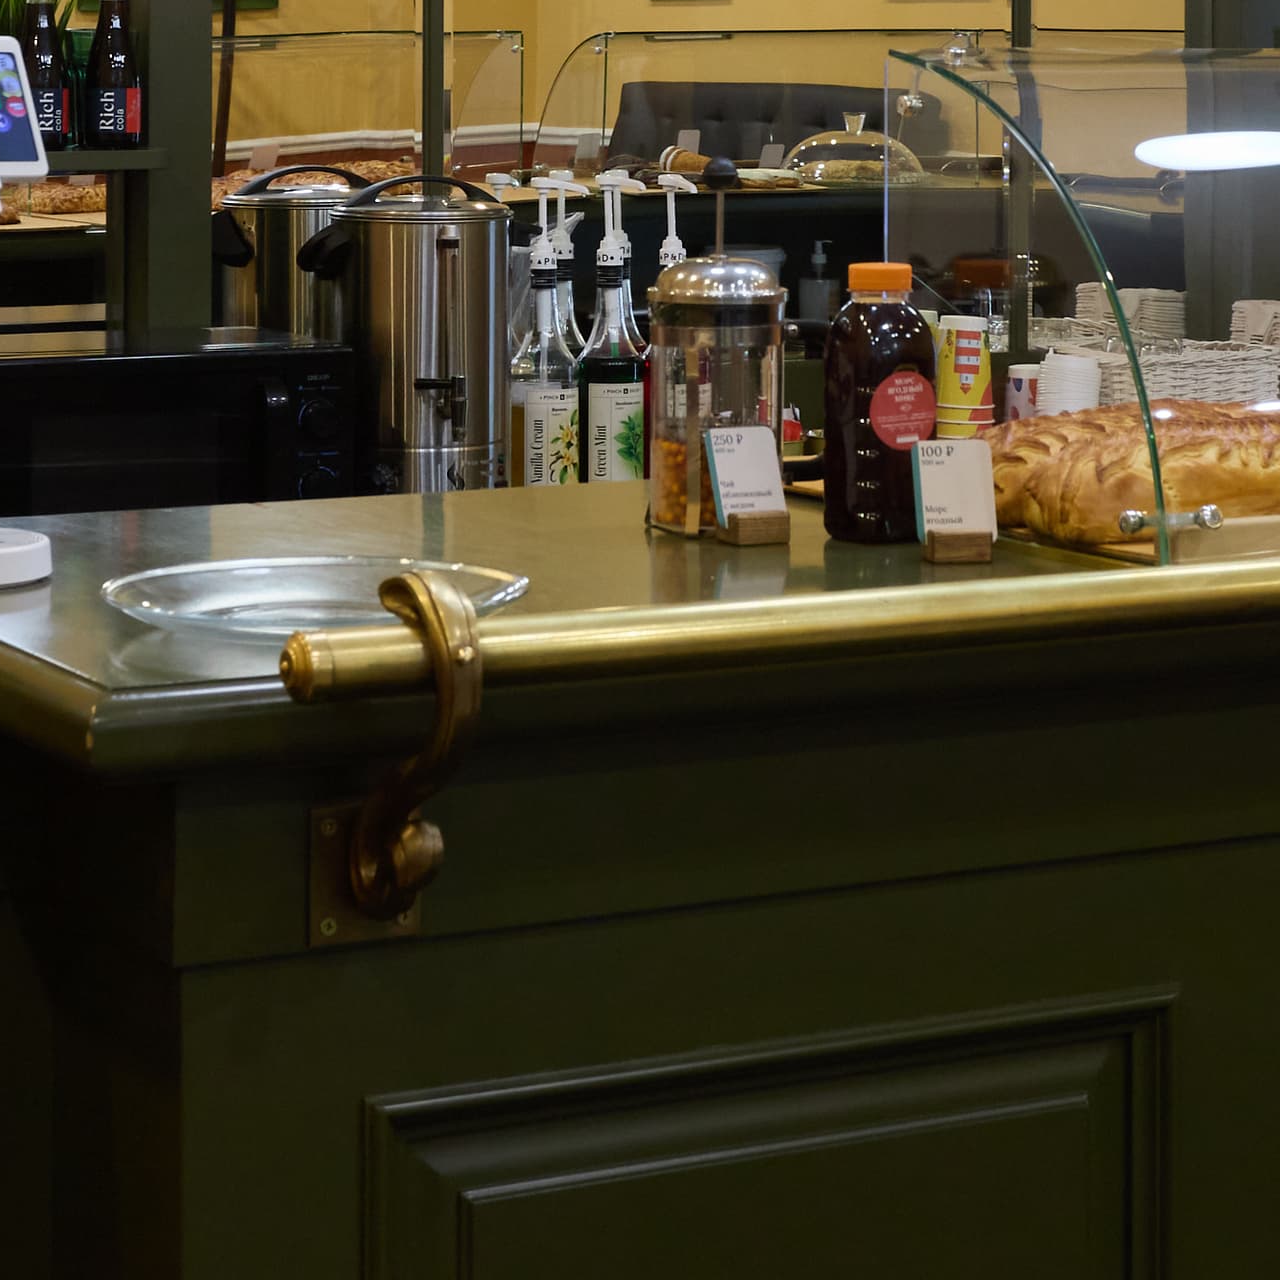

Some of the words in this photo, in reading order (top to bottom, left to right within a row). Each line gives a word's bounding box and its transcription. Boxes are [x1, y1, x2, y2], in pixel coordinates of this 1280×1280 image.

[40, 91, 55, 131] Rich
[99, 91, 115, 131] Rich
[116, 108, 125, 131] cola
[530, 420, 544, 450] Cream
[594, 425, 607, 446] Mint
[713, 433, 734, 446] 250
[594, 449, 607, 477] Green
[920, 446, 943, 457] 100
[925, 505, 947, 514] Морс
